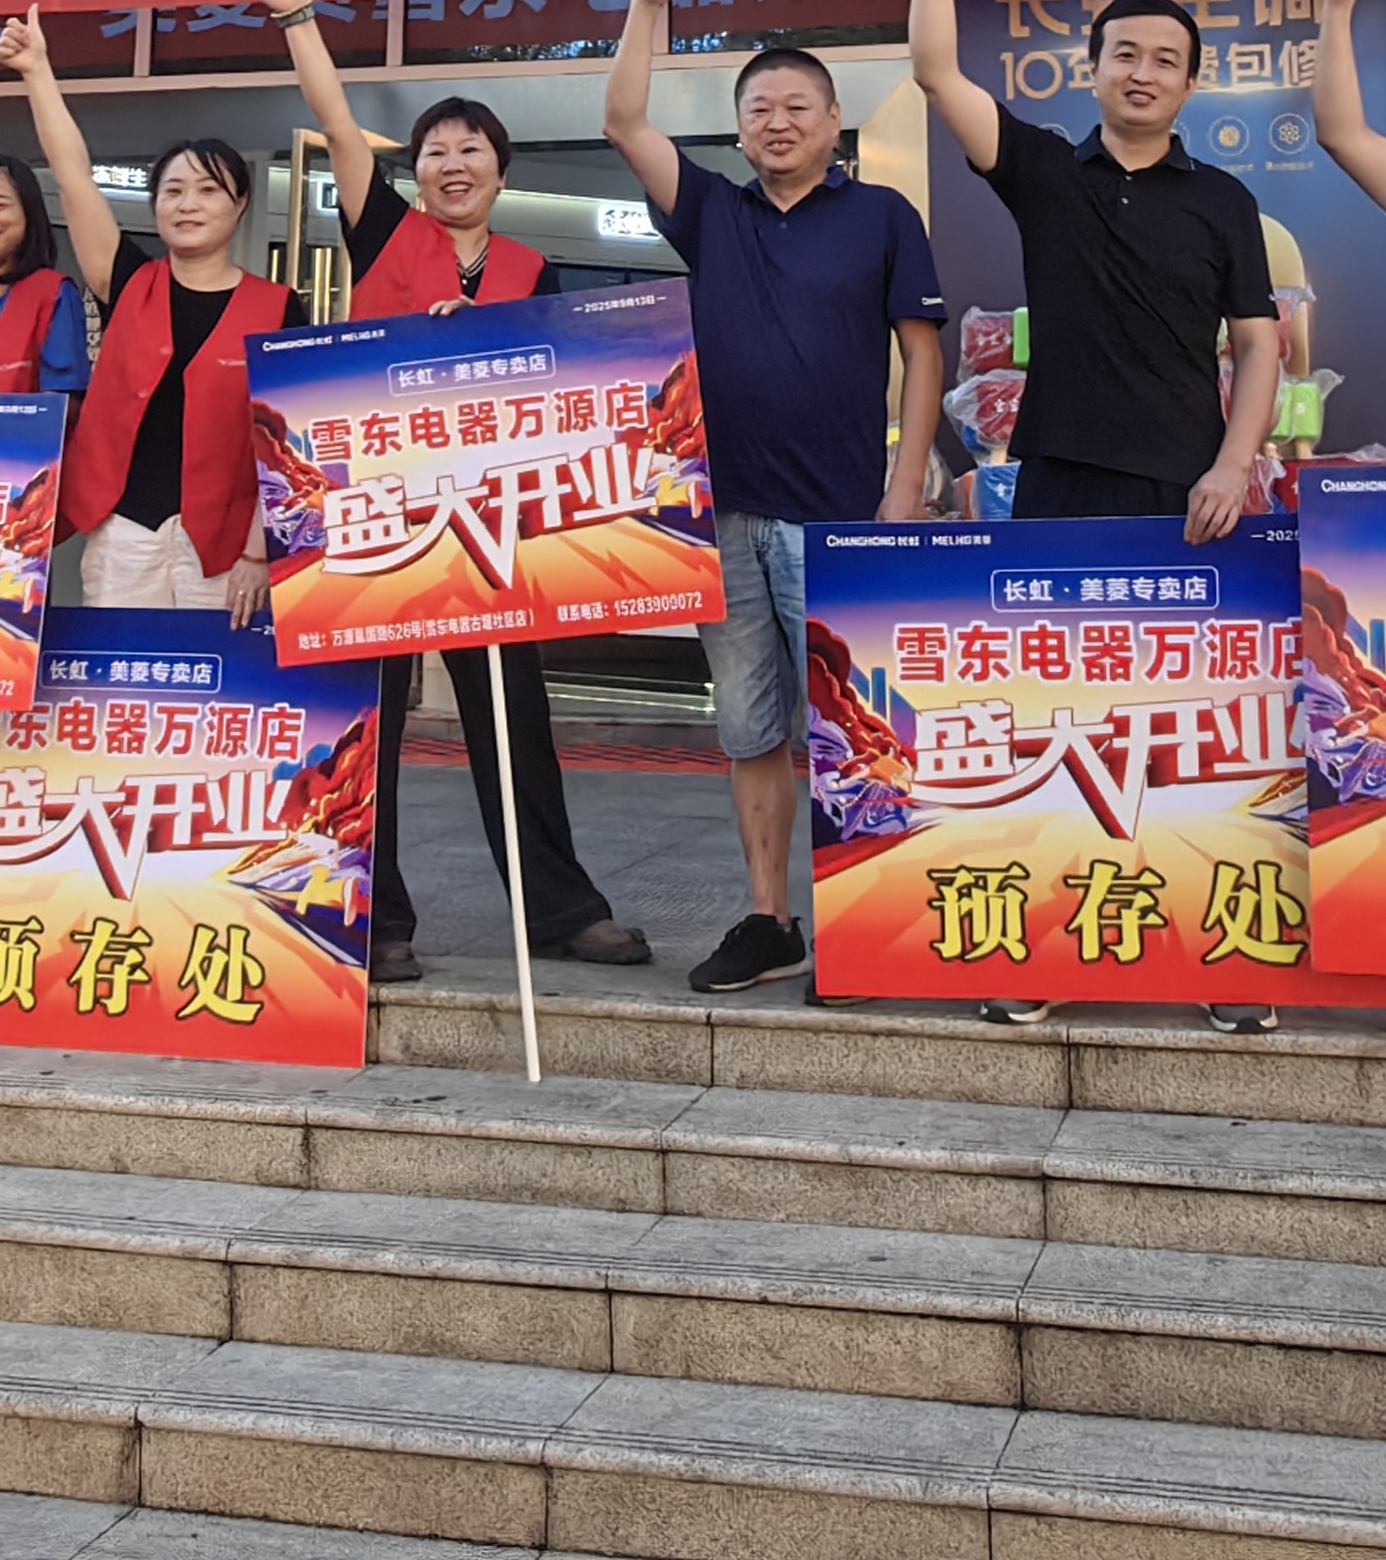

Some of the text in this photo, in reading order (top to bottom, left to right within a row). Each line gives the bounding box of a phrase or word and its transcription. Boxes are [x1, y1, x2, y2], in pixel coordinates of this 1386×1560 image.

[310, 381, 650, 465] 雪东电器万源店
[322, 442, 658, 590] 盛大开业
[894, 620, 1303, 684] 雪东电器万源店
[913, 694, 1308, 842] 盛大开业
[927, 861, 1309, 966] 预存处
